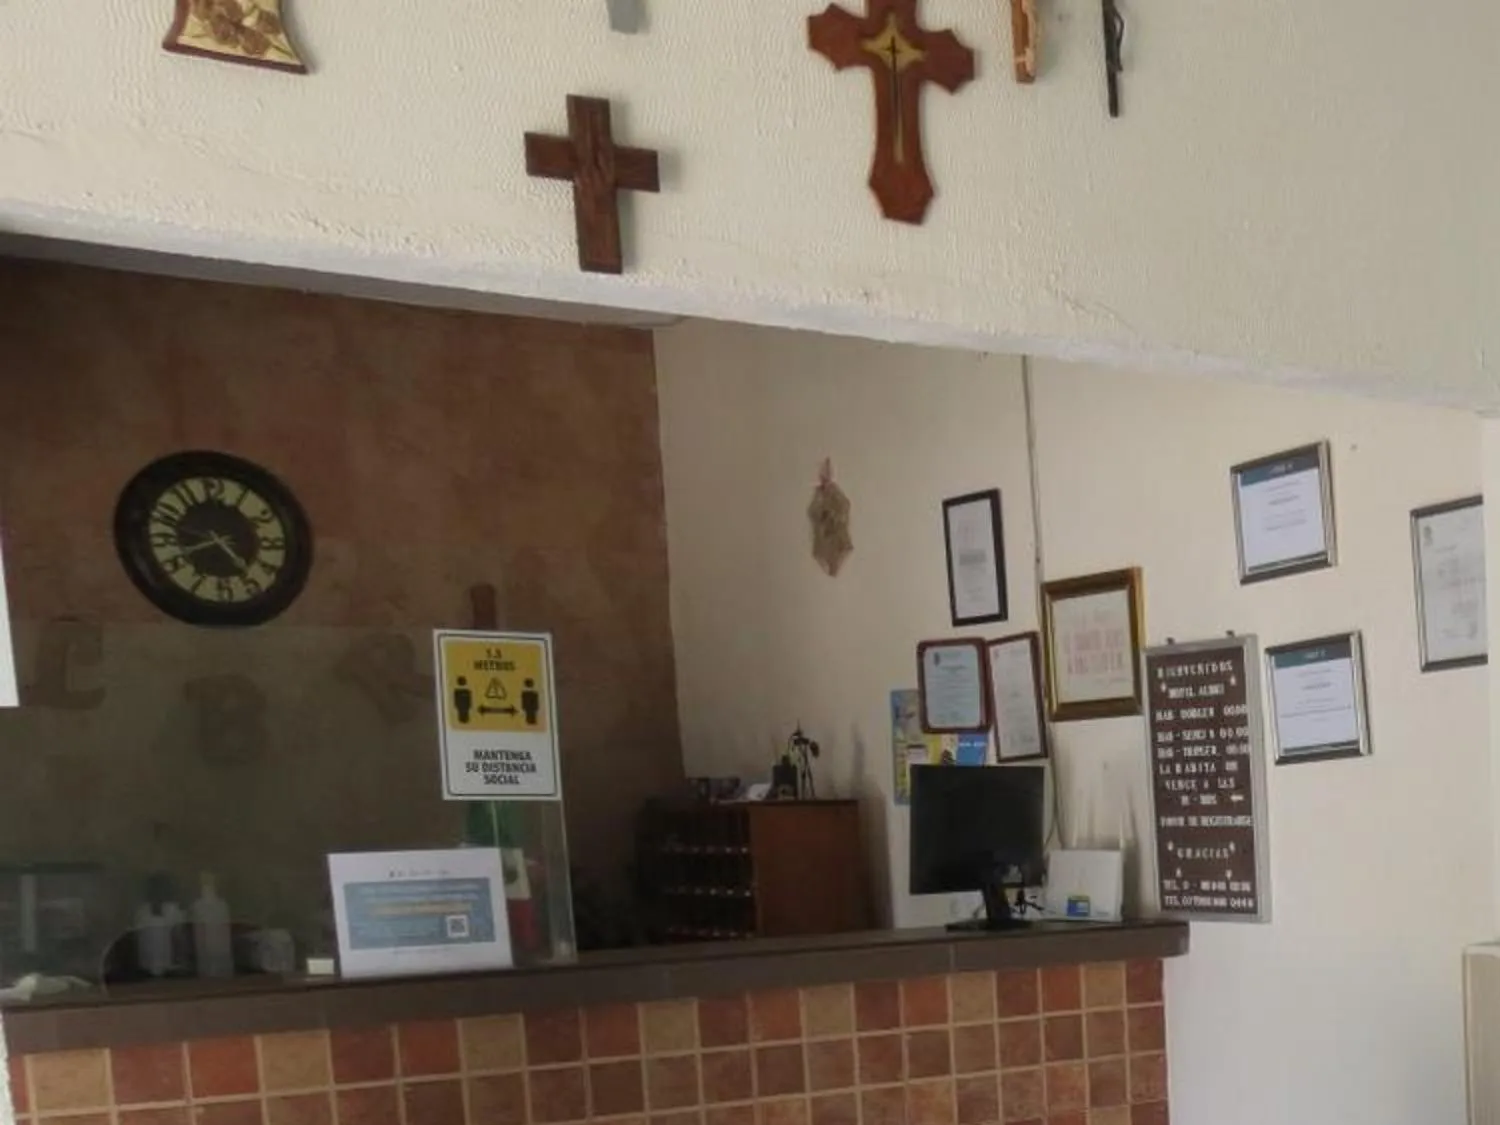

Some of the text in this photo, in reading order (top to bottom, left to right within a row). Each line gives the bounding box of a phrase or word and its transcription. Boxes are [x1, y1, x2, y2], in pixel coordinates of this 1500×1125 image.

[473, 749, 532, 762] MANTENGA
[465, 761, 537, 774] SU DISTANCIA
[483, 773, 520, 785] SOCIAL
